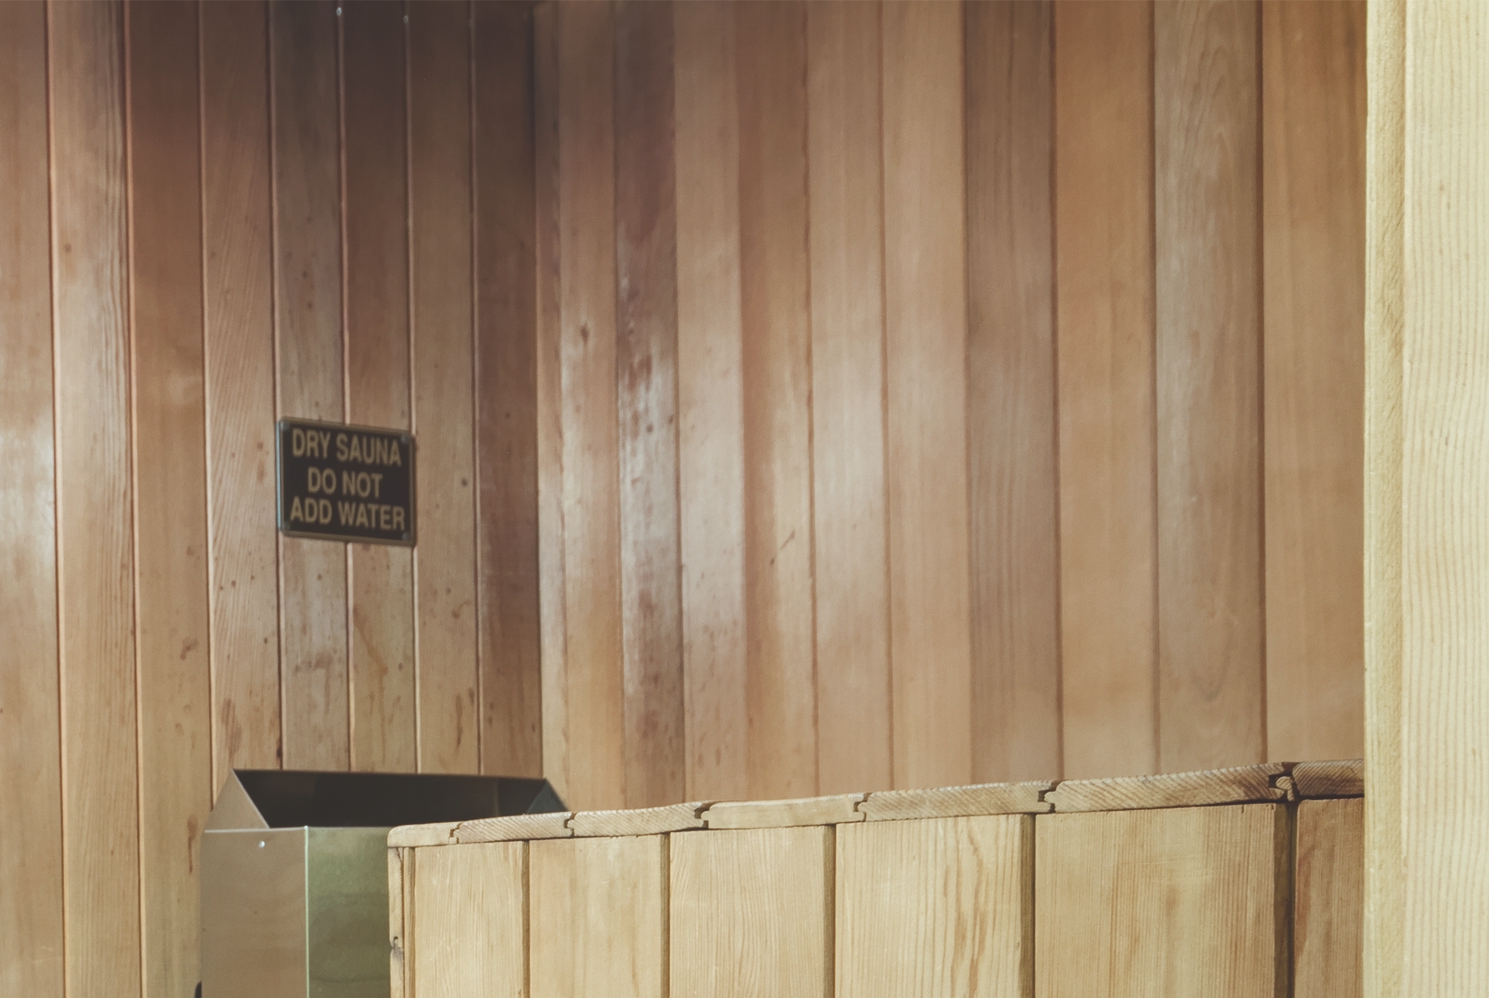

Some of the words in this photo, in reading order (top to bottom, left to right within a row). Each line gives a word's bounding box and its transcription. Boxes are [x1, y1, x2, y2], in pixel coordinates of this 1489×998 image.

[292, 428, 331, 459] DRY
[336, 433, 401, 466] SAUNA
[308, 467, 337, 494] DO
[342, 470, 383, 498] NOT
[290, 496, 332, 524] ADD
[338, 500, 405, 531] WATER
